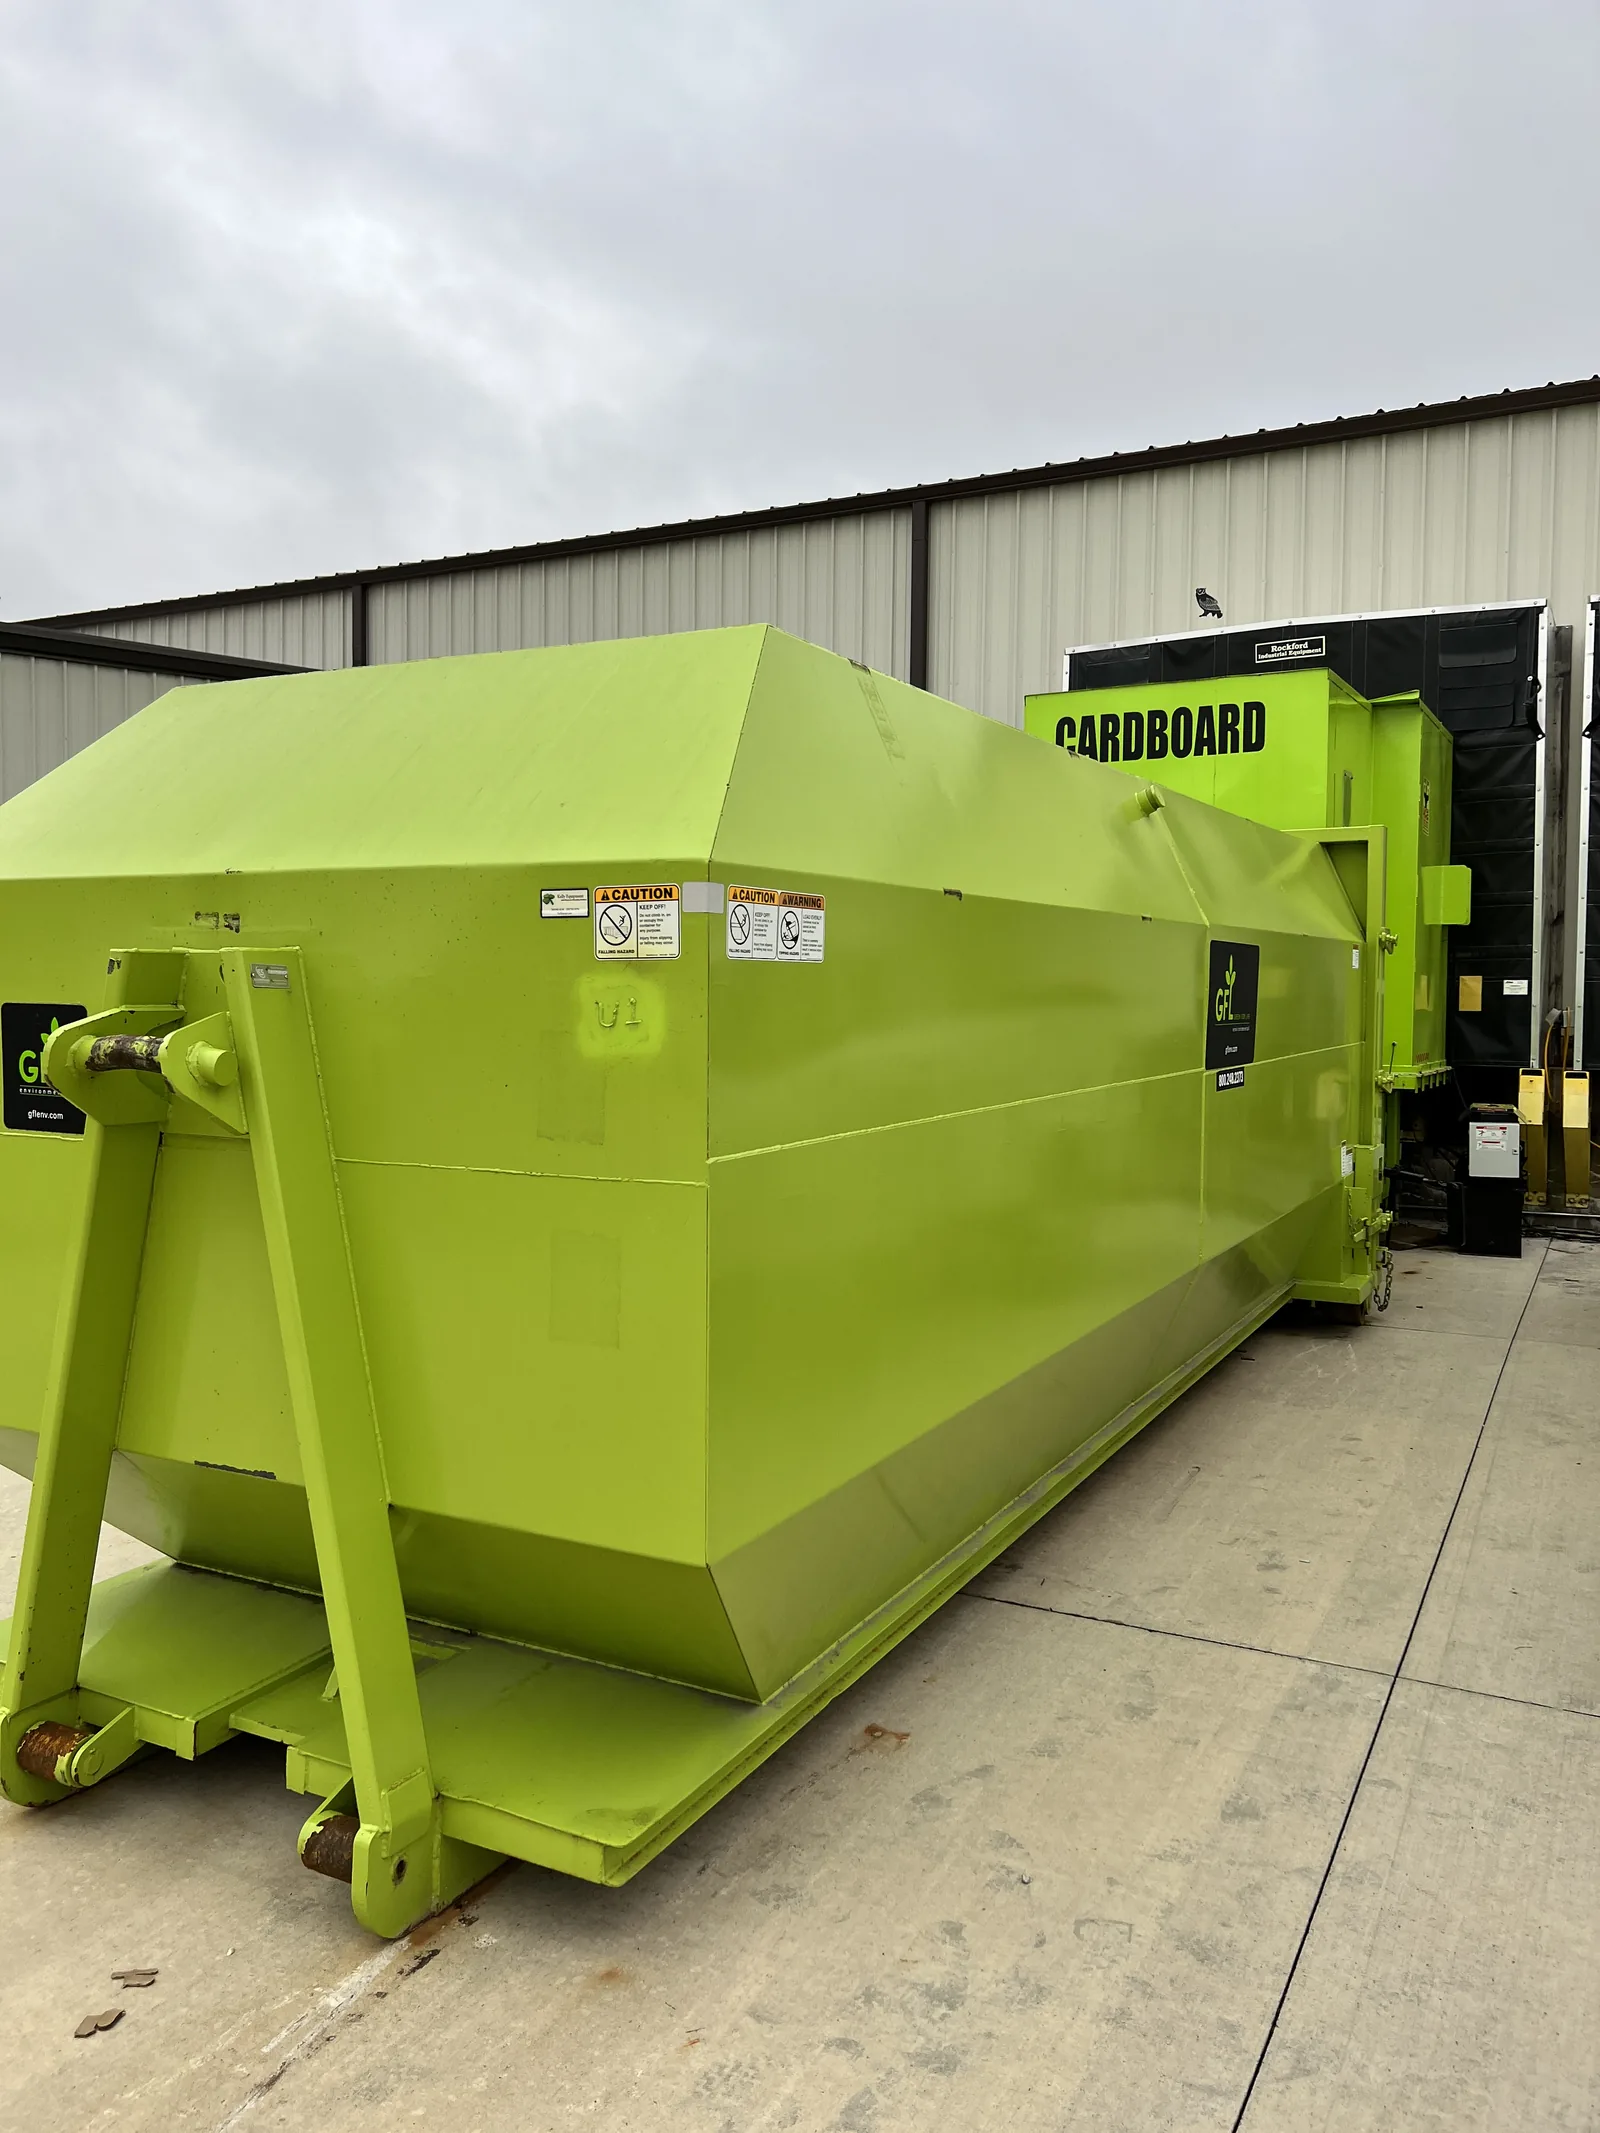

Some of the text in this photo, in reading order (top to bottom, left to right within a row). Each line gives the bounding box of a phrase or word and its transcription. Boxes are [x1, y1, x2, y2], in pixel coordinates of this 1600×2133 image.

[1271, 641, 1308, 652] Rockford
[1258, 648, 1321, 659] Industrial Equipment
[1056, 701, 1265, 762] CARDBOARD
[612, 887, 673, 900] CAUTION
[739, 889, 775, 903] CAUTION
[787, 895, 821, 908] WARNING
[1215, 983, 1234, 1021] GFL
[28, 1110, 64, 1120] gflenv.com
